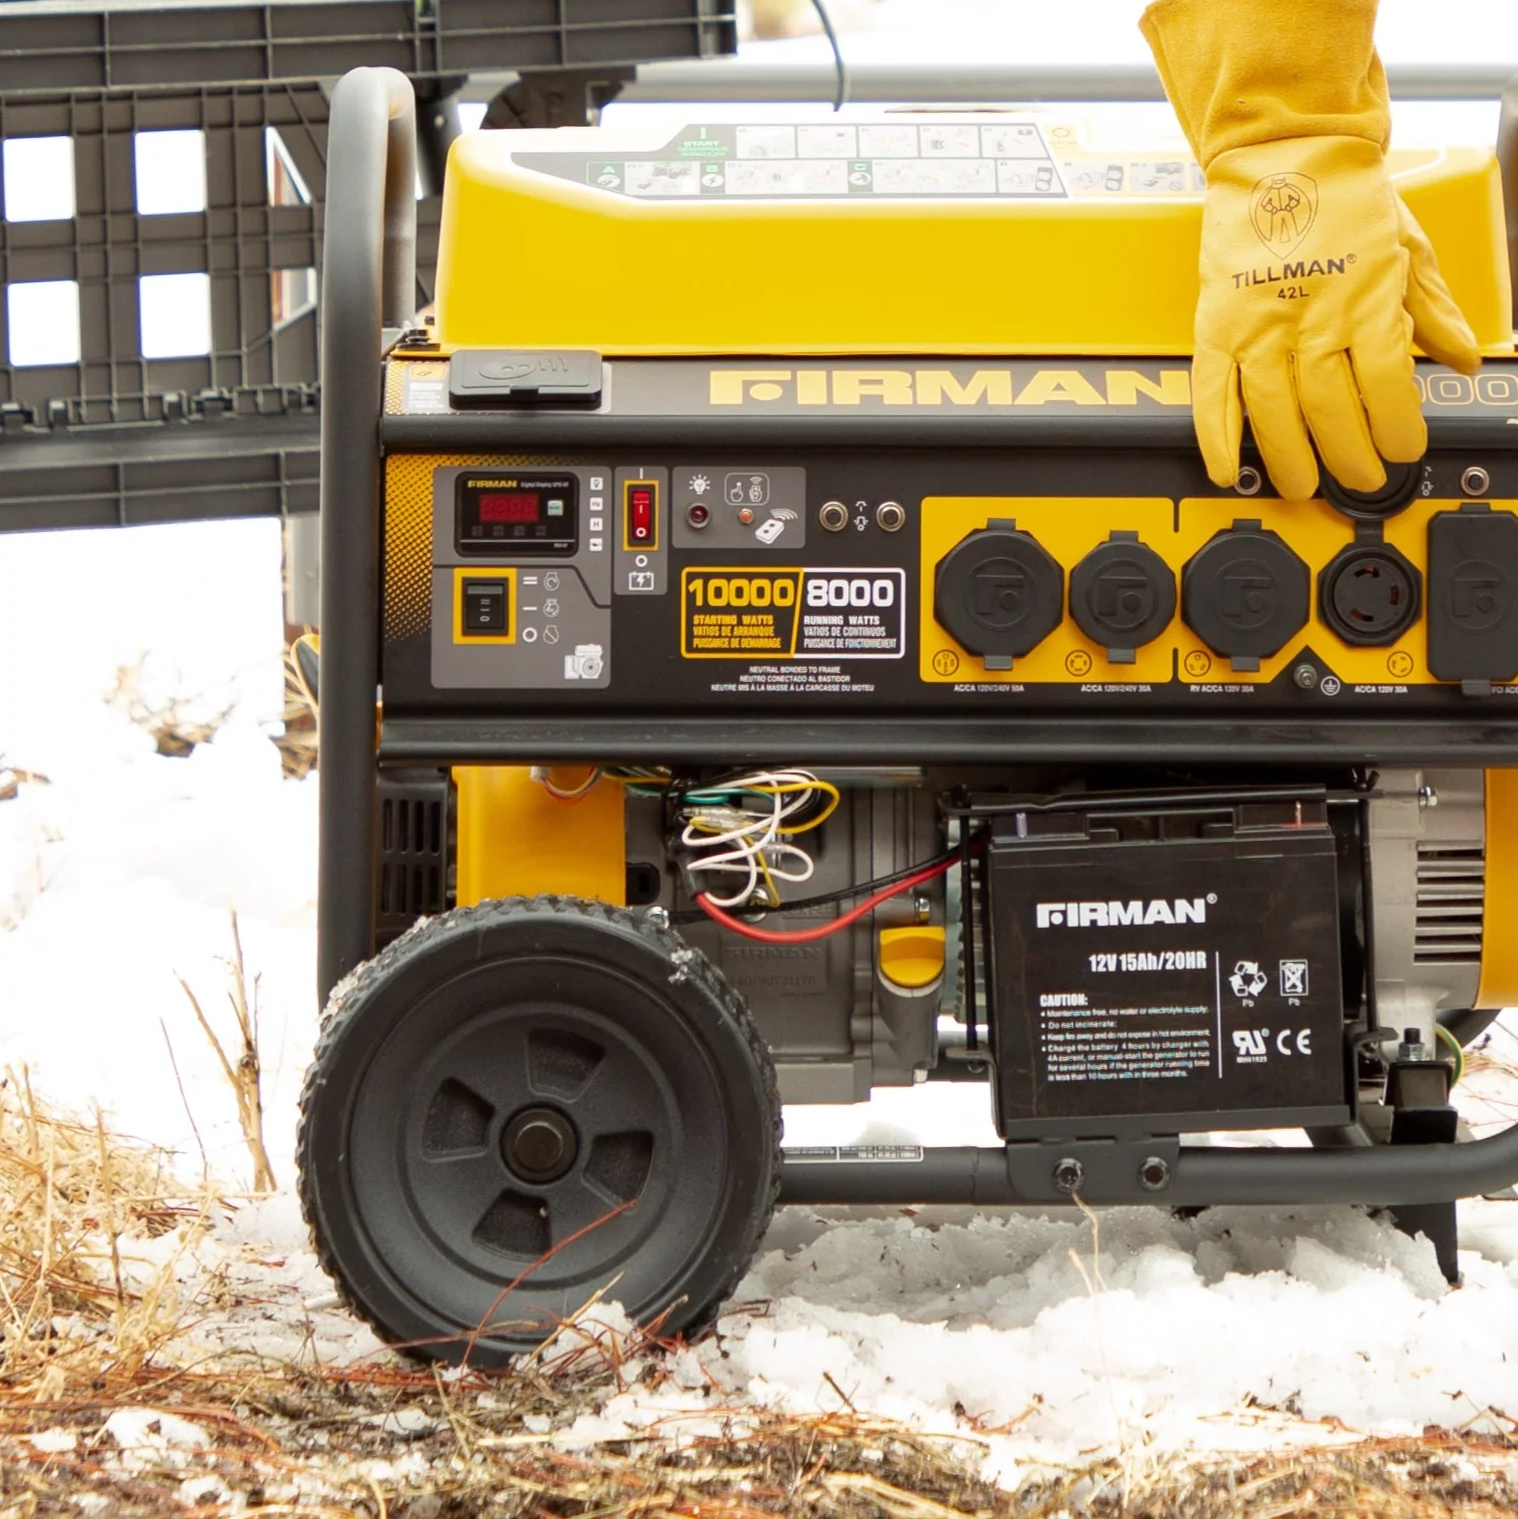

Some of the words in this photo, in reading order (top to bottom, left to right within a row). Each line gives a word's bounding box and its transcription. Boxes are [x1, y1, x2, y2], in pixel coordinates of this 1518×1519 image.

[1277, 285, 1310, 299] 42L
[709, 370, 1191, 405] FIRMAN
[467, 479, 518, 489] FIRMAN
[688, 578, 795, 607] 10000
[807, 579, 894, 607] 8000
[693, 614, 738, 626] STARTING
[742, 614, 774, 626] WATTS
[803, 615, 844, 626] RUNNING
[848, 615, 880, 626] WATTS
[693, 626, 719, 637] VATIOS
[721, 626, 732, 637] DE
[803, 626, 830, 637] VATIOS
[830, 626, 841, 637] DE
[843, 626, 886, 637] CONTINUOS
[836, 638, 845, 649] DE
[749, 666, 779, 674] NEUTRAL
[808, 666, 817, 674] TO
[818, 666, 841, 674] FRAME
[739, 675, 766, 683] NEUTRO
[767, 675, 807, 683] CONECTADO
[808, 675, 817, 683] AL
[711, 684, 736, 692] NEUTRE
[756, 684, 765, 692] LA
[795, 684, 805, 692] LA
[805, 684, 840, 692] CARCASSE
[841, 684, 850, 692] DU
[1089, 952, 1118, 972] 12V
[1119, 951, 1207, 971] 15Ah/20HR
[1039, 993, 1089, 1007] CAUTION:
[1242, 998, 1255, 1007] Pb
[1288, 997, 1301, 1006] Pb
[1119, 1007, 1139, 1015] water
[1148, 1006, 1184, 1015] electrolyte
[1061, 1021, 1074, 1029] not
[1048, 1034, 1065, 1042] Keep
[1276, 1028, 1312, 1055] CE
[1048, 1045, 1076, 1053] Charge
[1091, 1043, 1119, 1052] battery
[1128, 1042, 1150, 1050] hours
[1151, 1042, 1161, 1051] by
[1162, 1041, 1191, 1050] charger
[1192, 1040, 1209, 1048] with
[1154, 1051, 1188, 1060] generator
[1048, 1064, 1058, 1072] for
[1059, 1063, 1086, 1071] several
[1087, 1062, 1108, 1070] hours
[1128, 1061, 1164, 1070] generator
[1165, 1060, 1193, 1069] running
[1194, 1059, 1210, 1067] time
[1071, 1073, 1087, 1081] than
[1088, 1072, 1097, 1080] 10
[1097, 1072, 1118, 1080] hours
[1119, 1071, 1134, 1079] with
